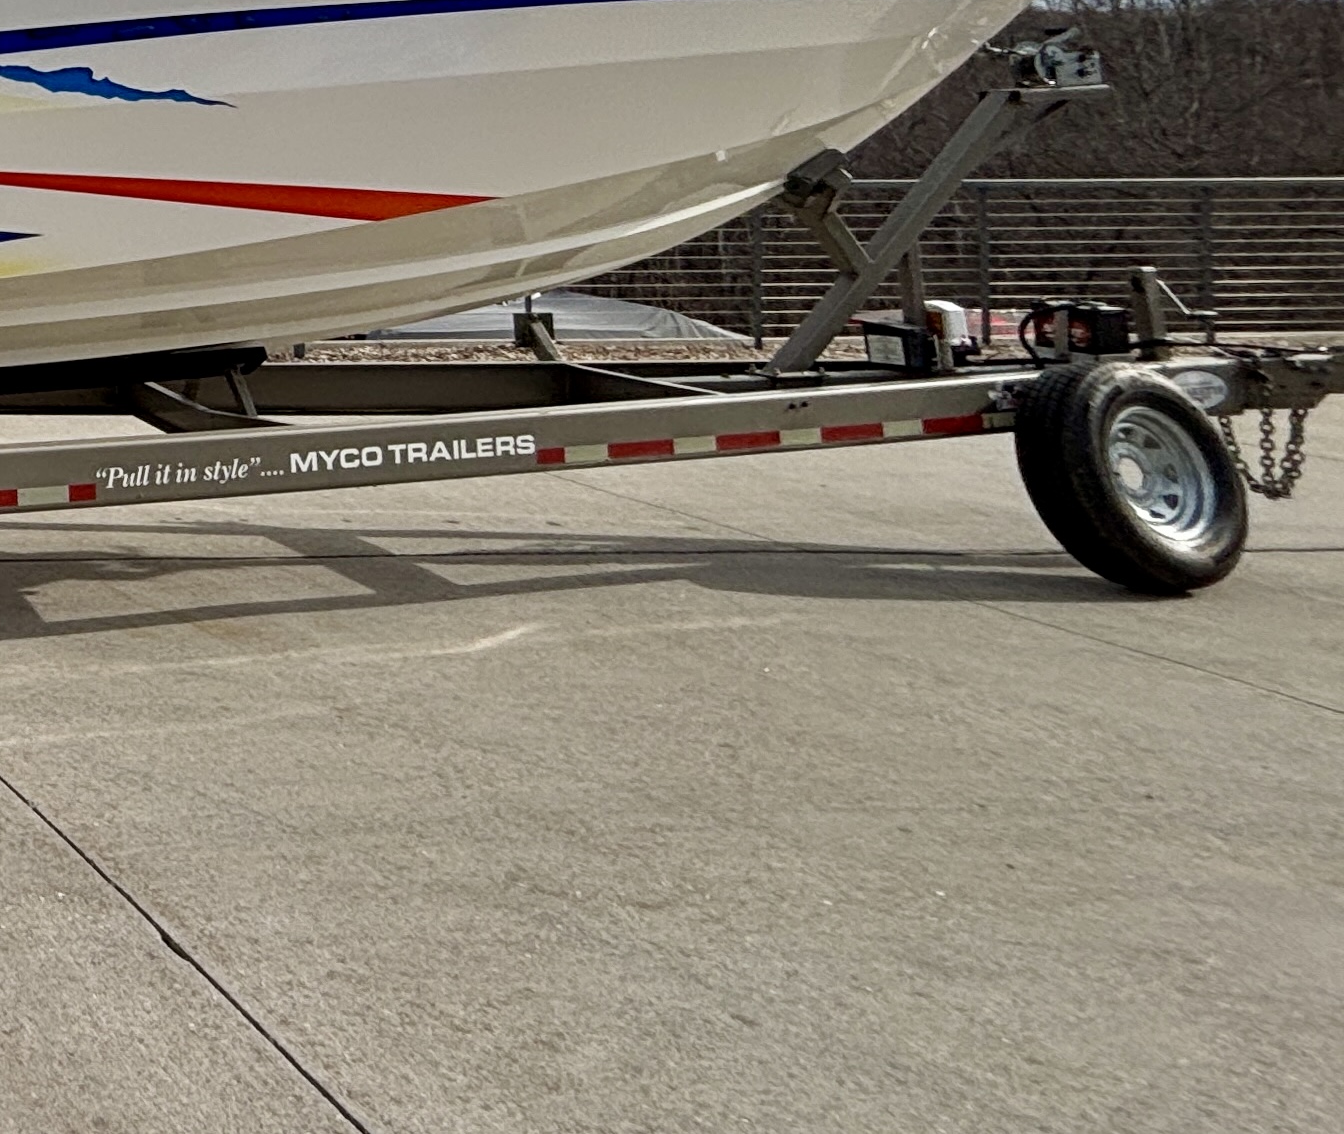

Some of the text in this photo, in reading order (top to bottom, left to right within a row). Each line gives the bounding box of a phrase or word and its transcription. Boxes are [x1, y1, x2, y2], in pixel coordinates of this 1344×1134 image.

[155, 463, 171, 484] it
[176, 462, 197, 483] in
[290, 446, 383, 473] MYCO
[388, 435, 535, 464] TRAILERS
